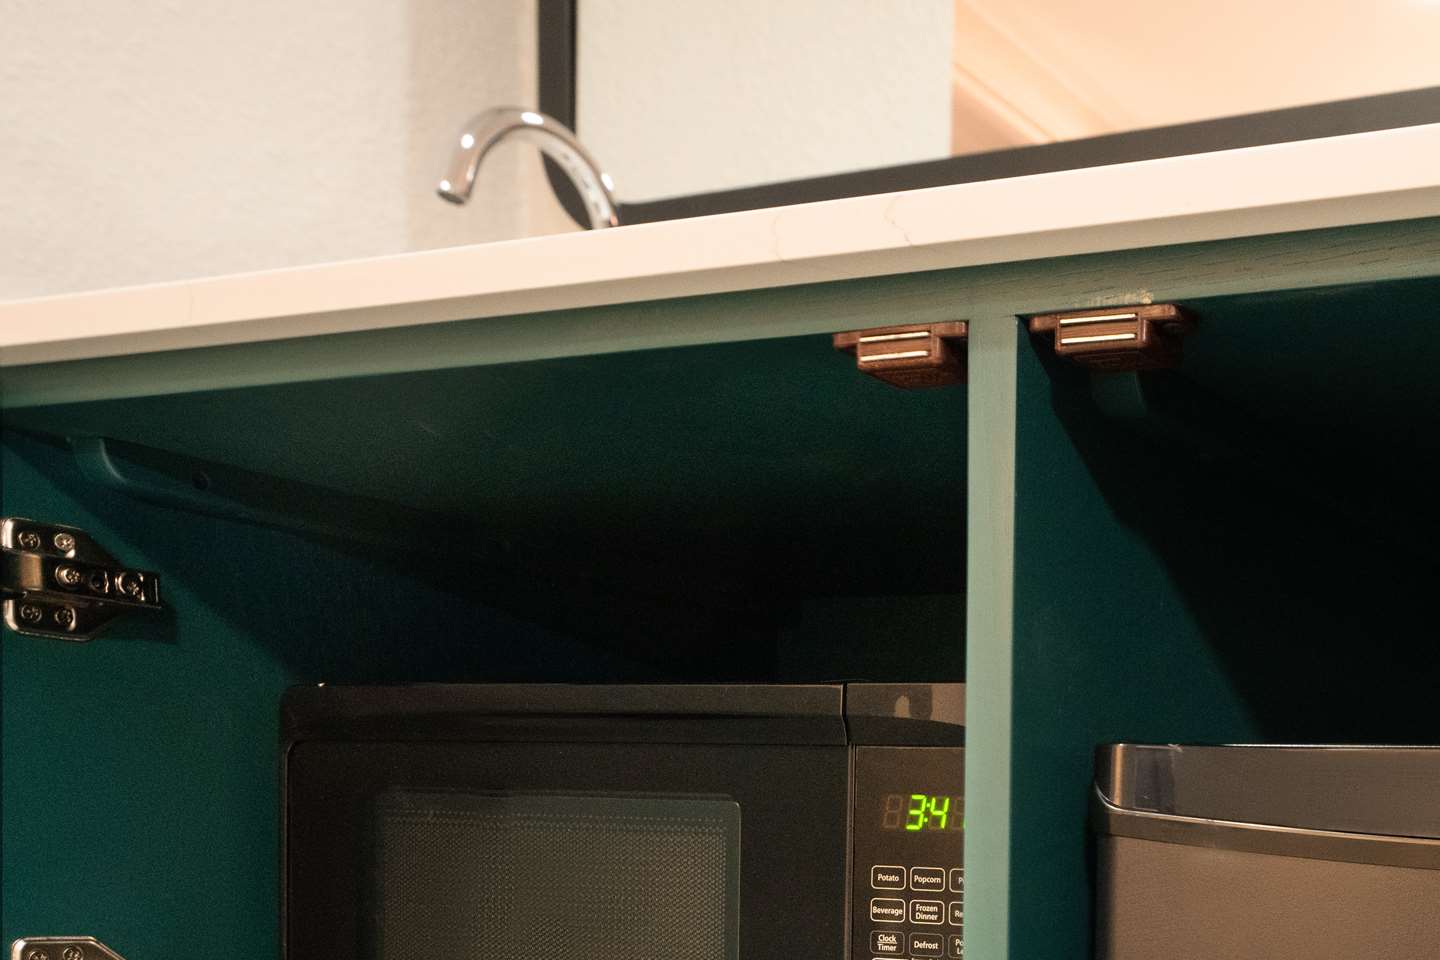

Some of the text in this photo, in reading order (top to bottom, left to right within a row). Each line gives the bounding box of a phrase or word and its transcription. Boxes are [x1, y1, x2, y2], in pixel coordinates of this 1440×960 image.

[906, 794, 960, 830] 3:4
[877, 873, 900, 882] Potato
[913, 875, 942, 885] Popcorn
[872, 906, 903, 916] Beverage
[915, 904, 938, 912] Frozen
[915, 912, 938, 920] Dinner
[878, 934, 897, 942] Clock
[877, 943, 897, 951] Timer
[913, 940, 939, 949] Defrost
